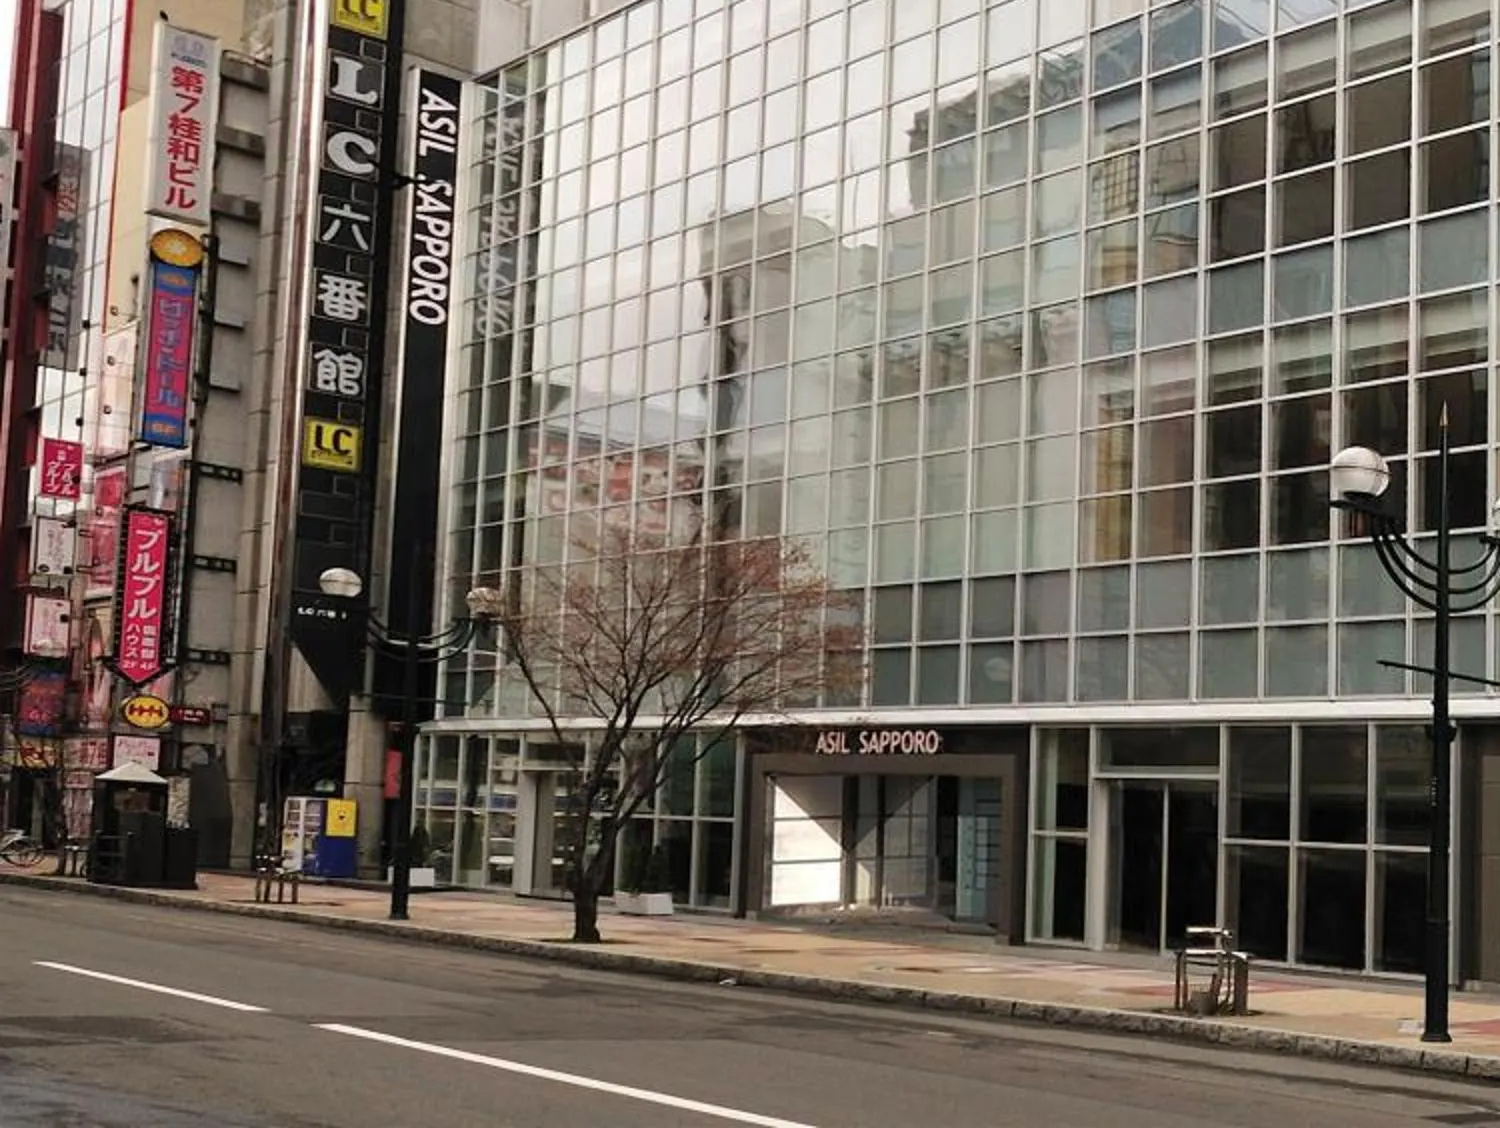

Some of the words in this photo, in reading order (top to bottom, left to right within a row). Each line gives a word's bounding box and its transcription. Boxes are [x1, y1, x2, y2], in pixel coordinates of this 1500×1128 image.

[418, 88, 457, 157] ASIL
[409, 173, 453, 326] SAPPORO
[314, 424, 353, 455] LC
[816, 730, 851, 754] ASIL
[859, 729, 940, 754] SAPPORO
